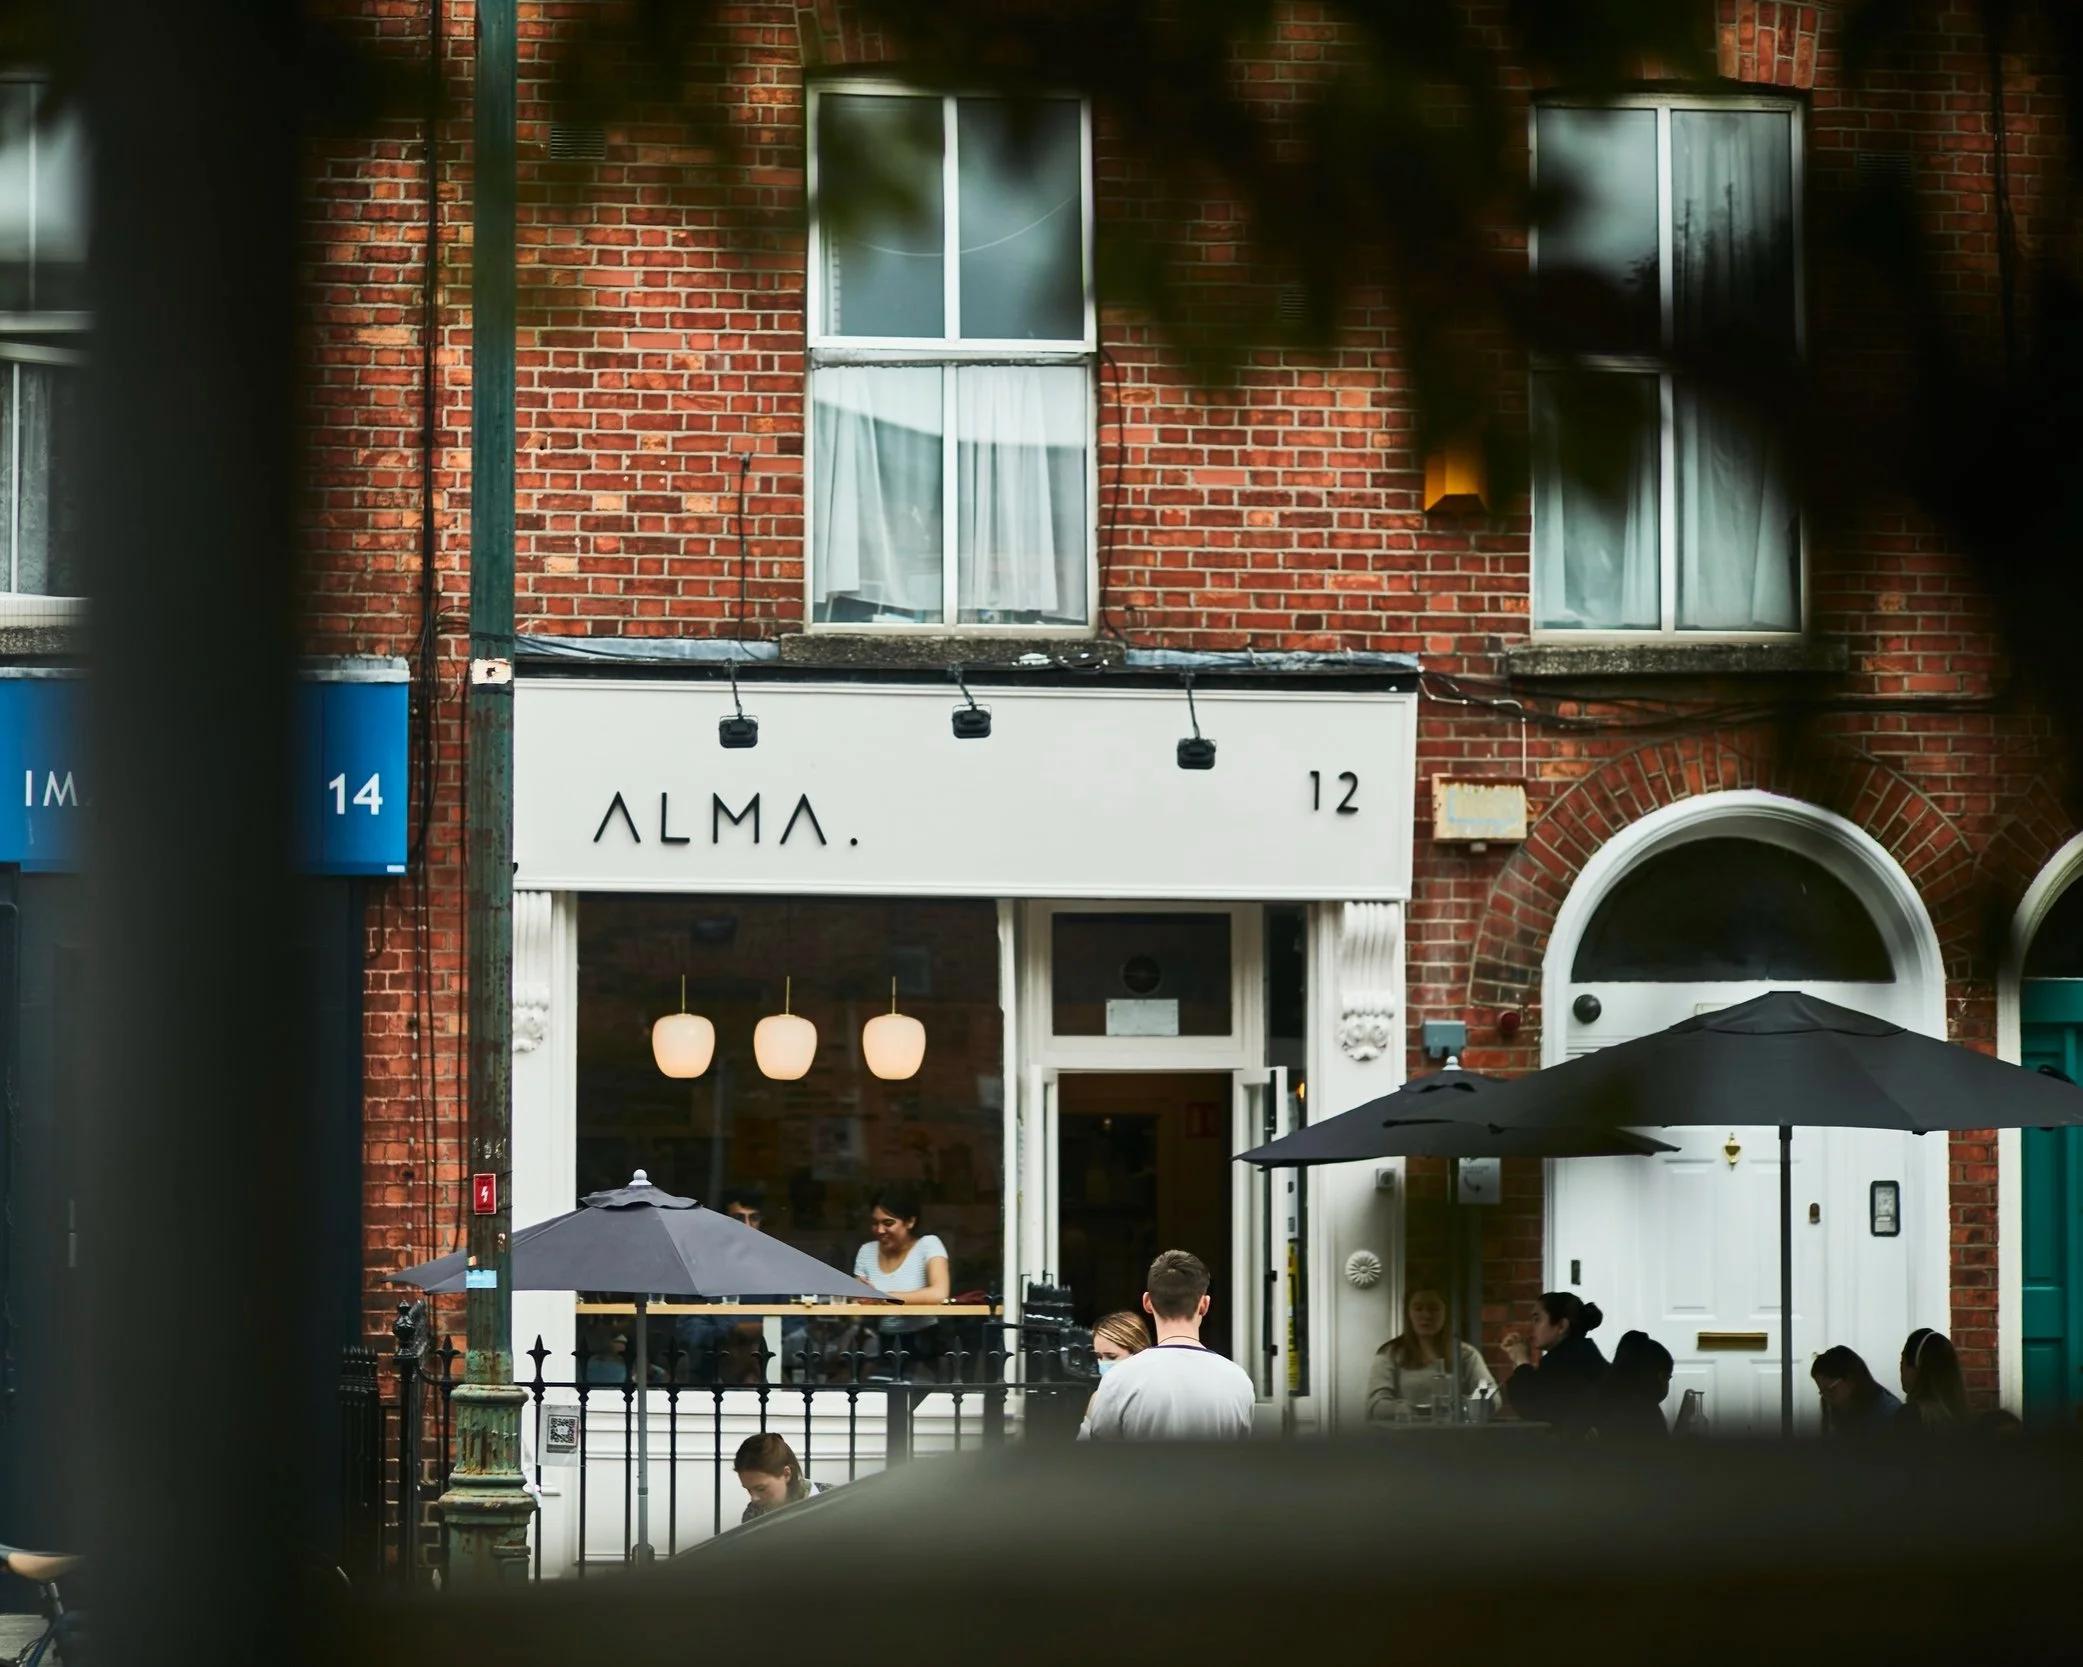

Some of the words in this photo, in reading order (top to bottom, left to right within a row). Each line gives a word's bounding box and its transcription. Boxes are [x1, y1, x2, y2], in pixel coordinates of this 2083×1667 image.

[24, 769, 93, 807] IM
[328, 772, 383, 815] 14
[1309, 770, 1359, 814] 12
[593, 790, 859, 846] ALMA.
